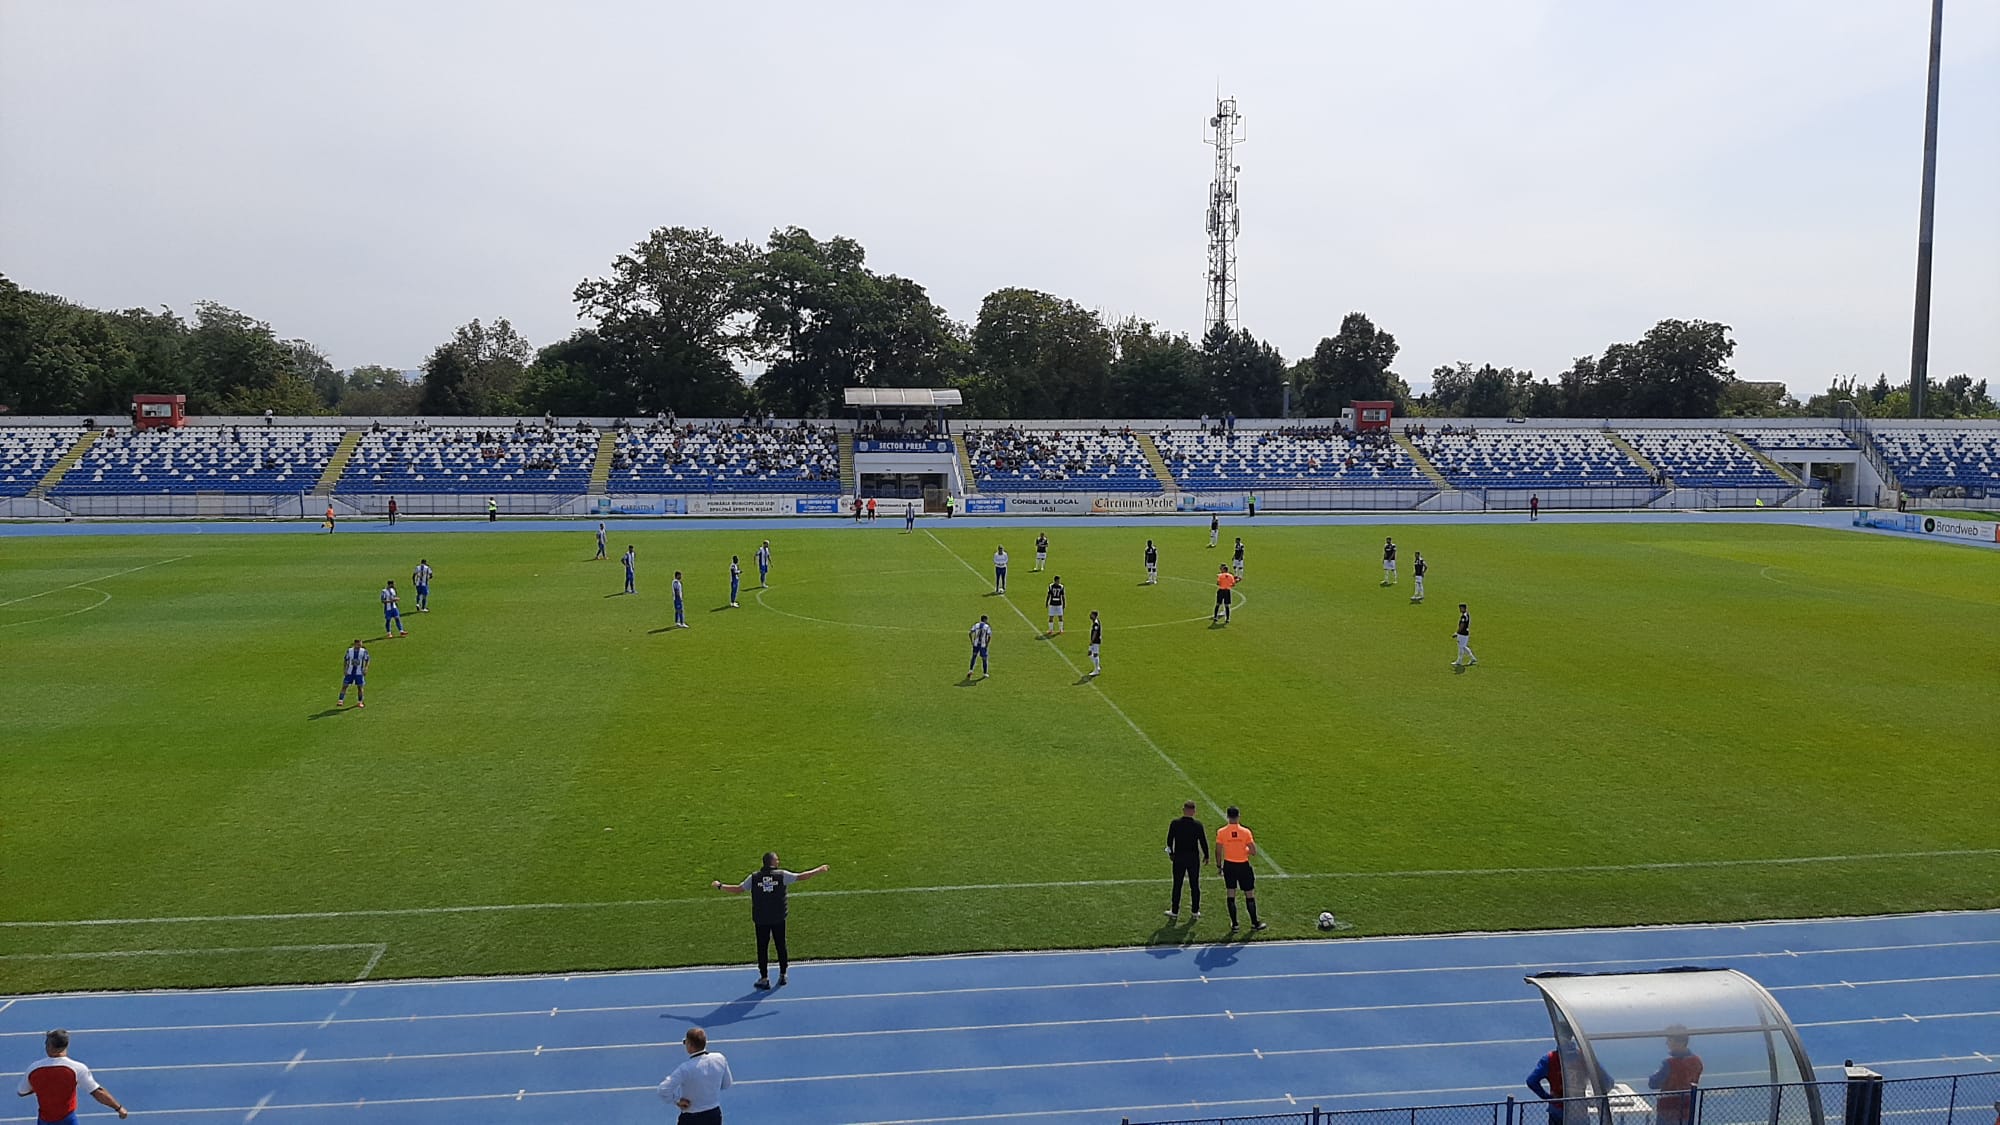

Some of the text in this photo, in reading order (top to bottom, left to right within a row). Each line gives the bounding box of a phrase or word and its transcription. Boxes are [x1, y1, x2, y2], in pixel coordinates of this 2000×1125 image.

[879, 442, 904, 450] SECTOR
[1145, 497, 1174, 509] Veche
[1936, 520, 1979, 536] Brandweb
